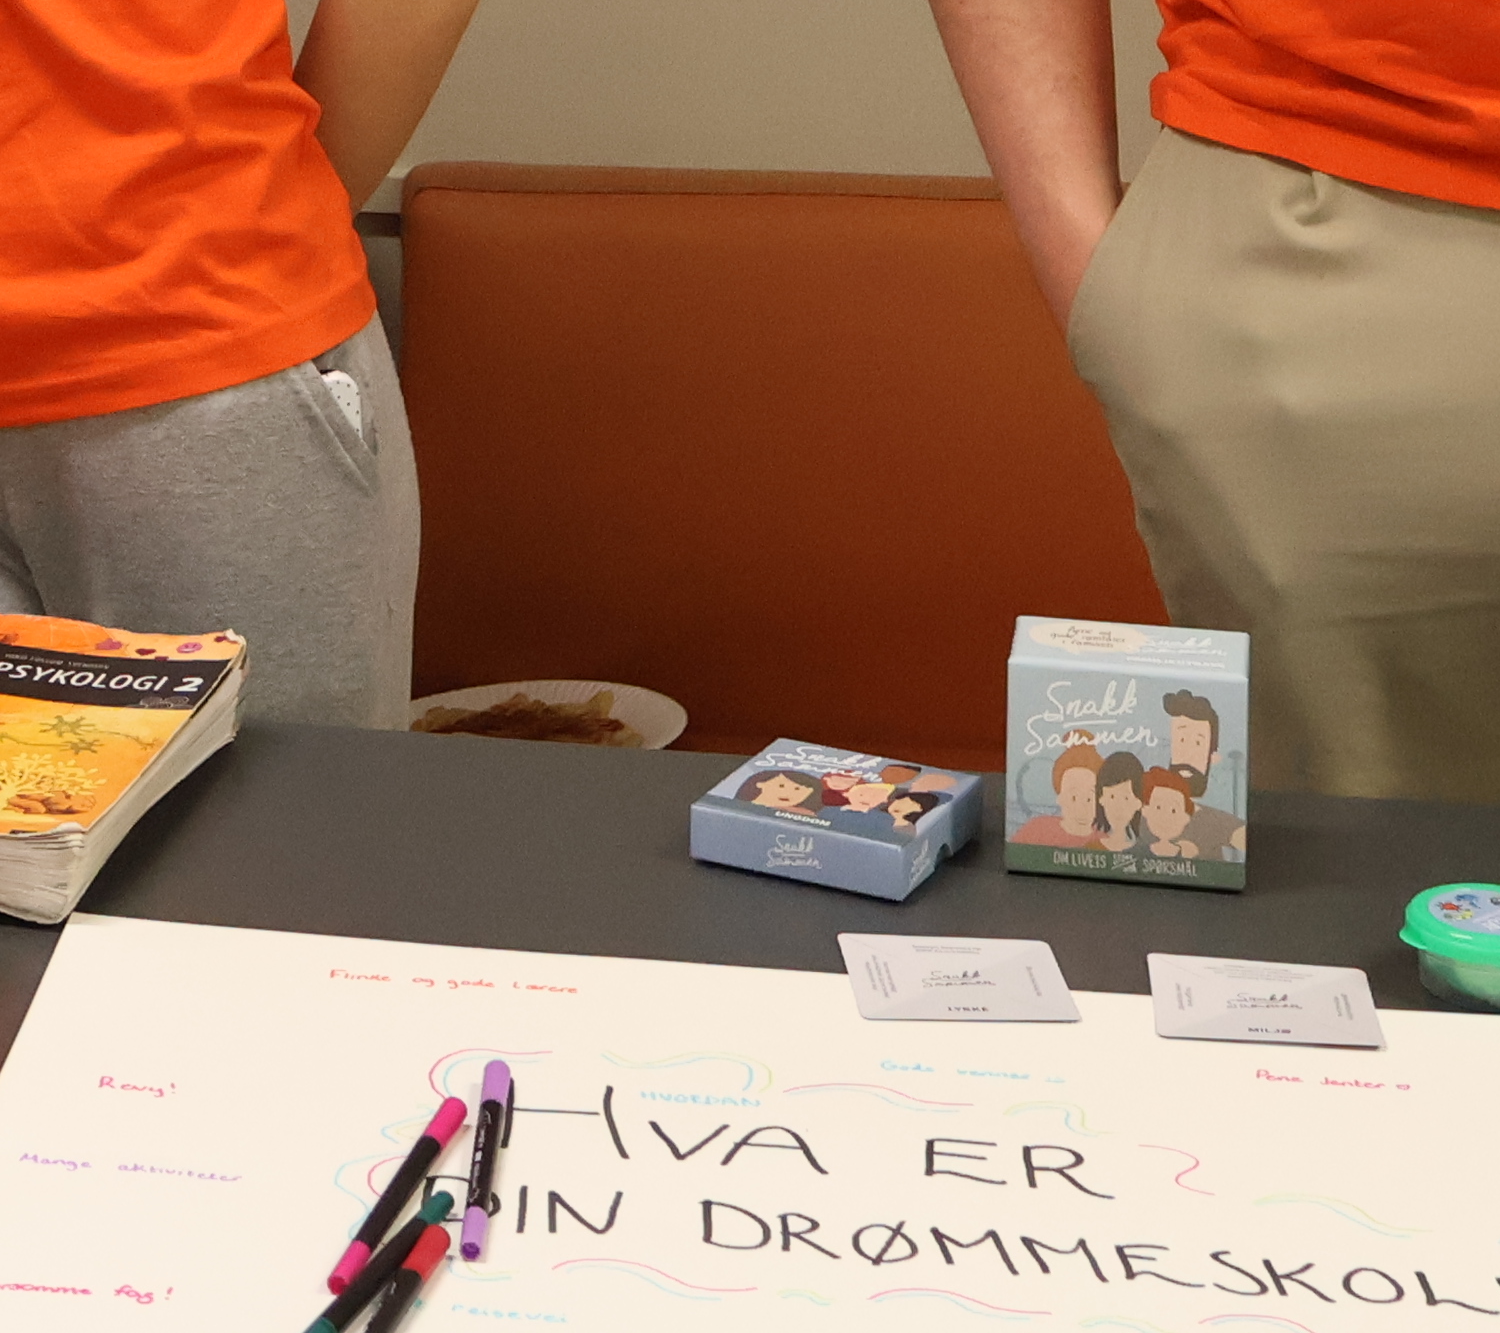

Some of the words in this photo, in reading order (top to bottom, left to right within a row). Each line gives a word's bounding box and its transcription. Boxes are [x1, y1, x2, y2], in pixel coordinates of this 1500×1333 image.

[172, 676, 205, 692] 2
[1044, 677, 1138, 723] Snakk
[1023, 713, 1160, 755] Sammen
[774, 809, 832, 827] UNGDOM
[411, 976, 436, 988] og
[500, 1076, 829, 1175] HVA
[923, 1136, 1116, 1200] ER
